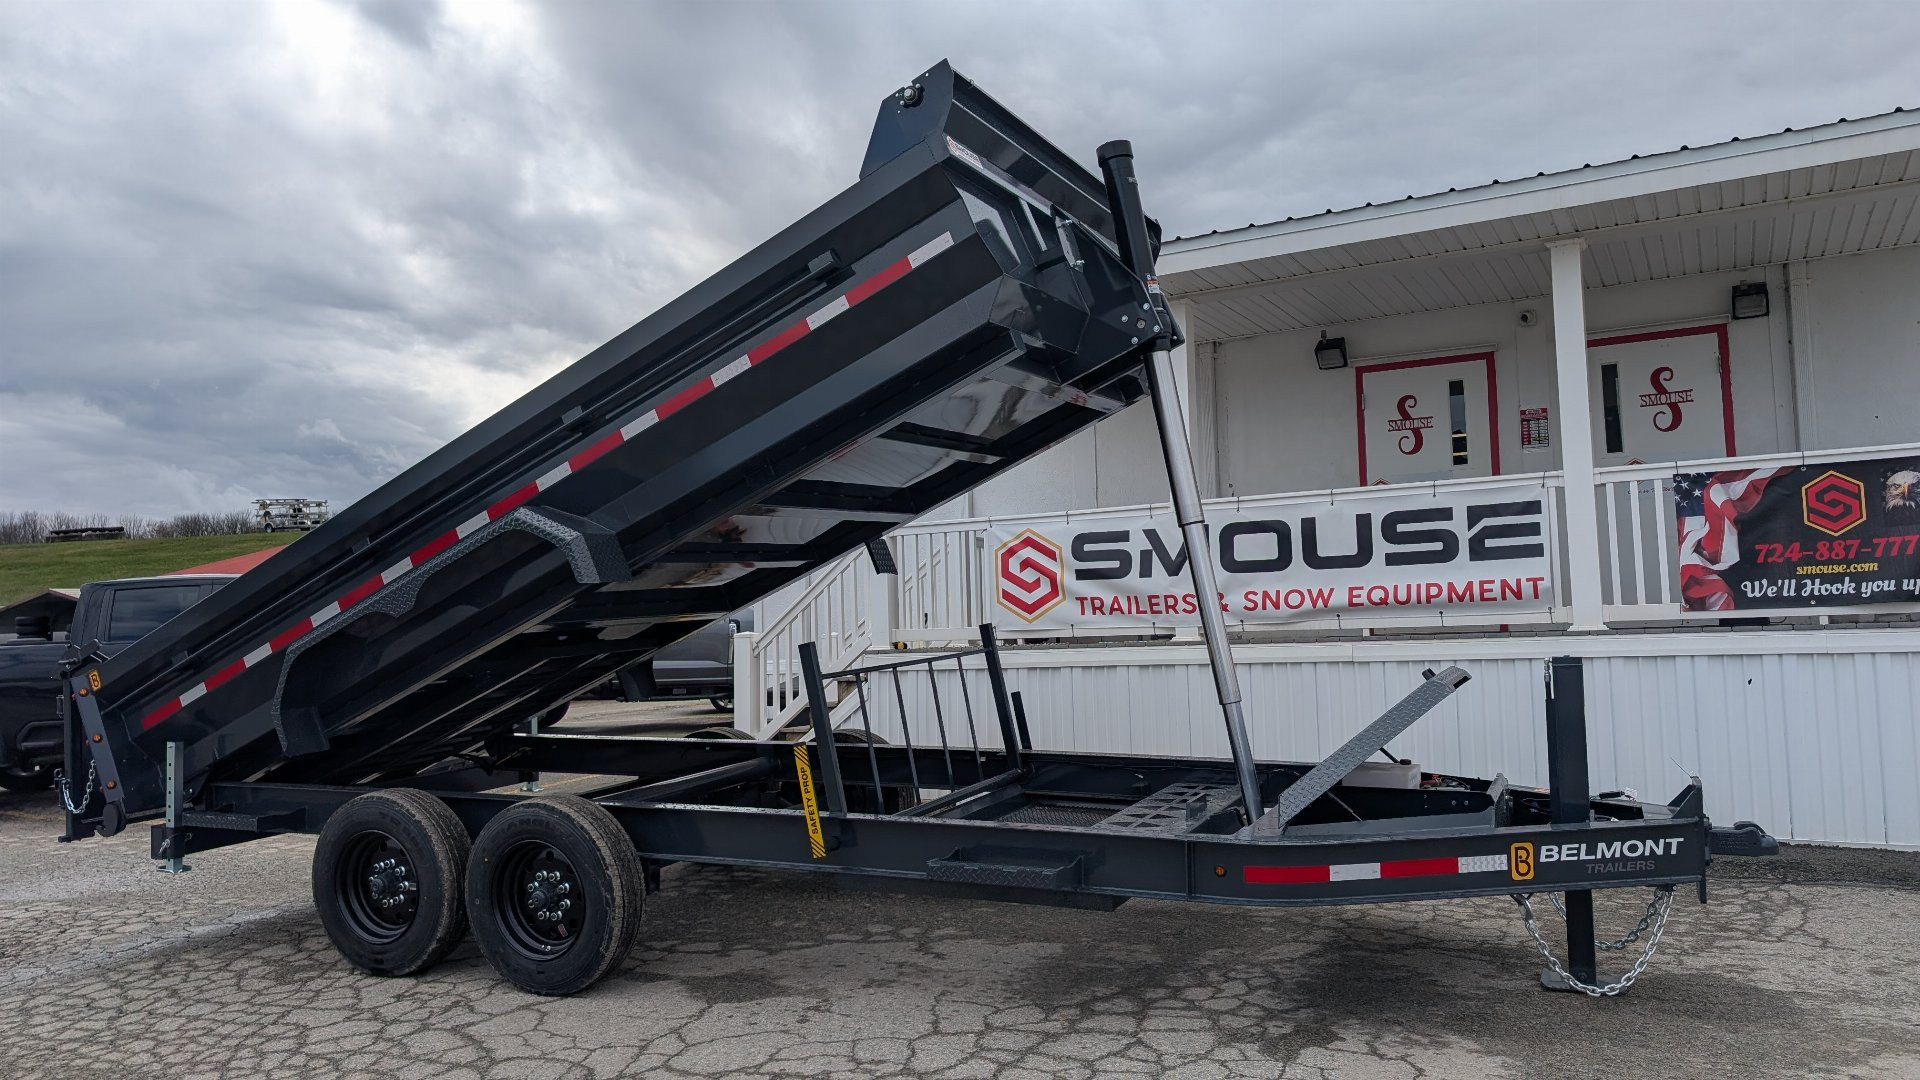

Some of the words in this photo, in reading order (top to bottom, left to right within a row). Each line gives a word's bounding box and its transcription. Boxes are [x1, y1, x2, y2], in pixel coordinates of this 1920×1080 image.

[1640, 390, 1693, 407] SMOUSE
[1387, 417, 1433, 431] SMOUSE
[1071, 500, 1545, 581] SMOUSE
[1796, 562, 1879, 575] smouse.com
[1075, 592, 1199, 617] TRAILERS
[1242, 587, 1335, 612] SNOW
[1347, 576, 1545, 608] EQUIPMENT
[1741, 579, 1797, 598] We'll
[1801, 576, 1857, 596] Hook
[1861, 579, 1897, 598] you
[800, 766, 811, 794] PROP
[805, 797, 819, 835] SAFETY
[1539, 837, 1685, 863] BELMONT
[1585, 860, 1656, 875] TRAILERS
